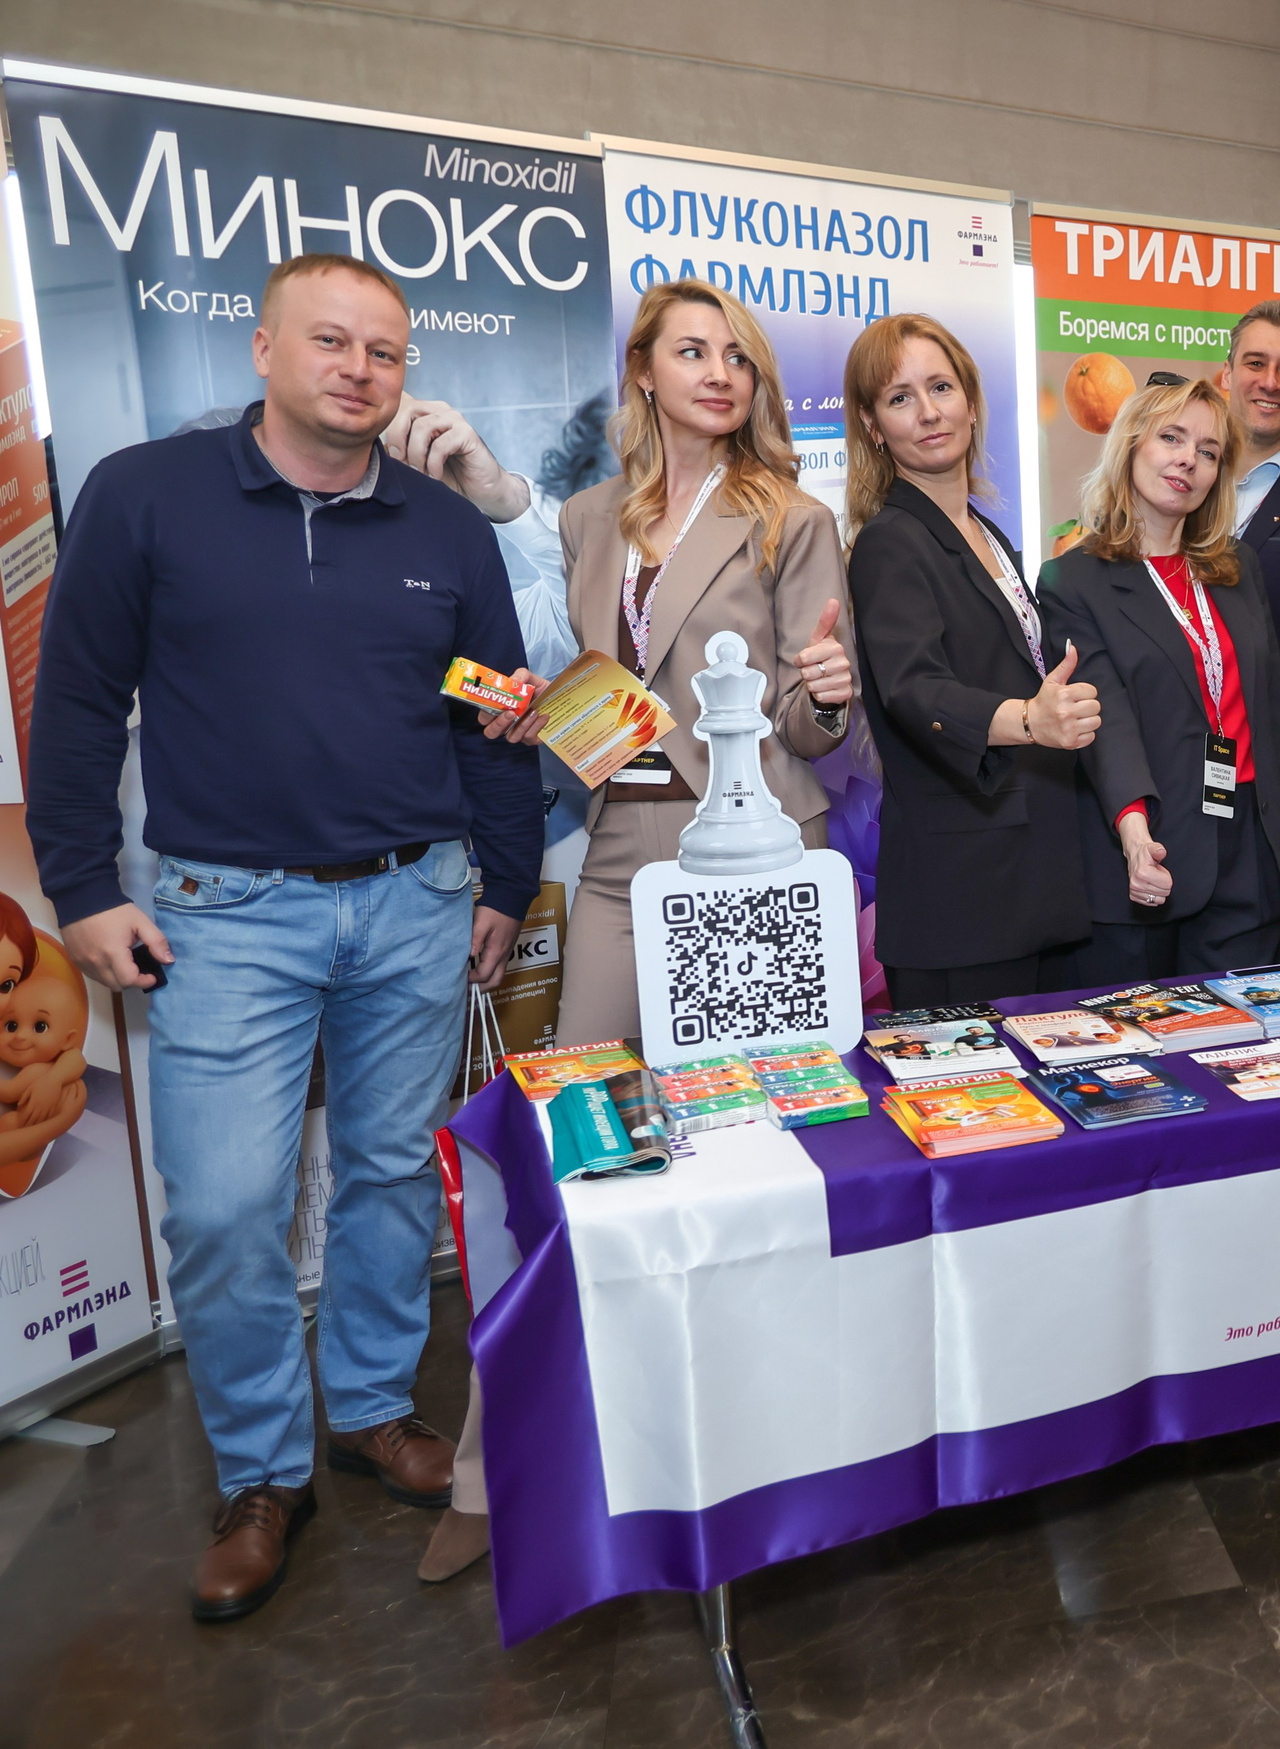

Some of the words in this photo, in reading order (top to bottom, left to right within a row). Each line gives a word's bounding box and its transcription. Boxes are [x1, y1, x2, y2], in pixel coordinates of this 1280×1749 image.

[424, 144, 577, 195] Minoxidil
[38, 116, 589, 291] МИНОКС
[625, 184, 930, 263] ФЛУКОНАЗОЛ
[957, 230, 998, 242] ФАРМЛЭНД
[138, 280, 256, 322] Когда
[411, 309, 516, 336] имеют
[1059, 310, 1149, 343] Боремся
[1156, 324, 1166, 340] с
[1171, 325, 1233, 354] просту
[463, 683, 518, 708] ТРИАЛГИН
[499, 982, 536, 995] выпадения
[538, 977, 558, 986] волос
[1169, 984, 1201, 994] ЕПТ
[1014, 1012, 1089, 1023] Лактуло
[514, 1041, 620, 1059] ТРИАЛГИН
[895, 1073, 1001, 1092] ТРИАЛГИН
[24, 1281, 132, 1340] ФАРМЛЭНД
[1224, 1323, 1254, 1341] Это
